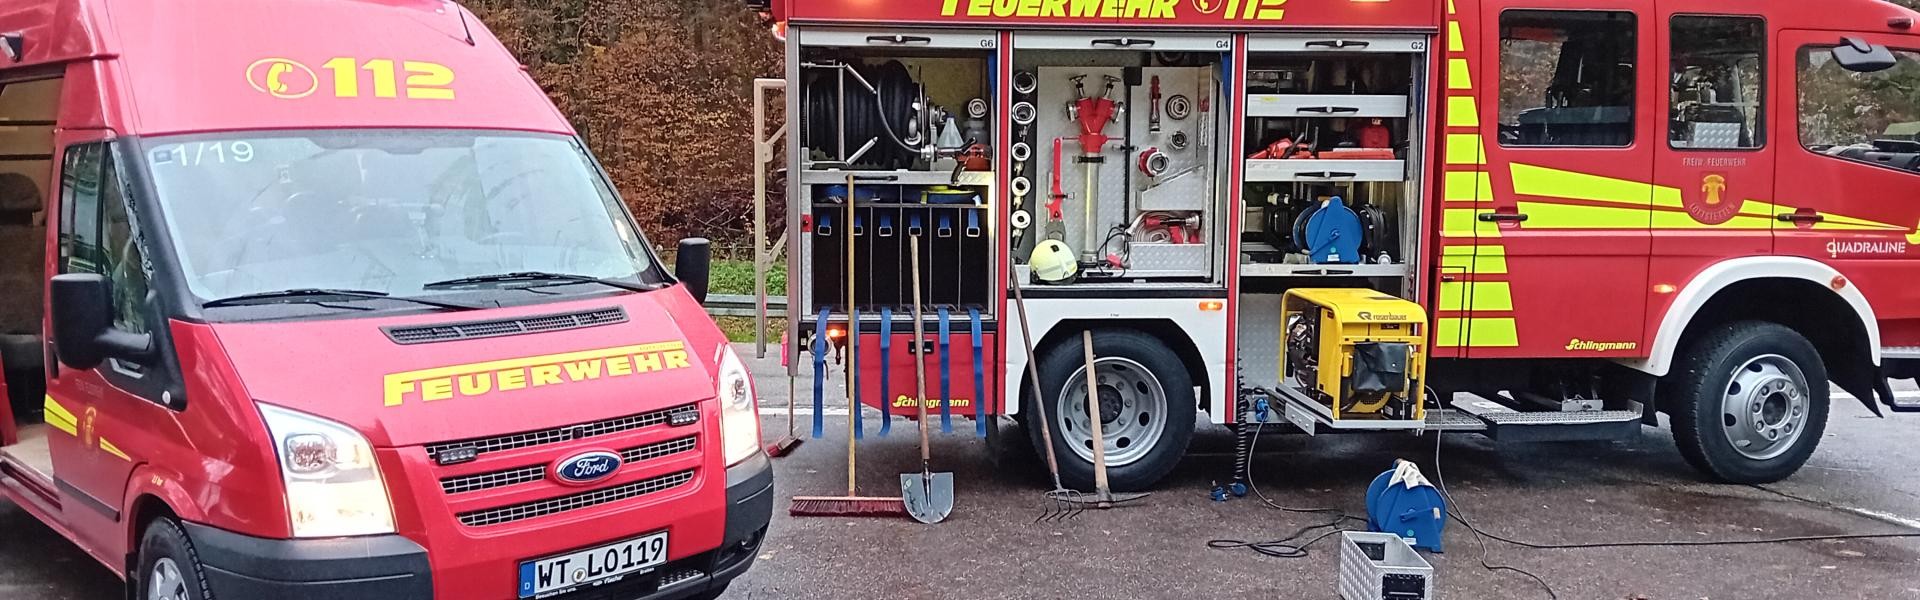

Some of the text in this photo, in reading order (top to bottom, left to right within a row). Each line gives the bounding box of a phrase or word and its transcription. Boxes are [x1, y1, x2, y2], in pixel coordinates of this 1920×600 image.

[980, 39, 994, 48] G6
[1215, 40, 1229, 49] G4
[1411, 41, 1424, 50] G2
[322, 57, 455, 100] 112
[172, 141, 254, 167] 1/19
[1707, 157, 1746, 167] FEUERWEHR
[1565, 338, 1636, 351] Schlingmann
[384, 340, 690, 407] FEUERWEHR
[574, 457, 609, 477] Ford
[538, 558, 571, 588] WT
[524, 582, 531, 590] D
